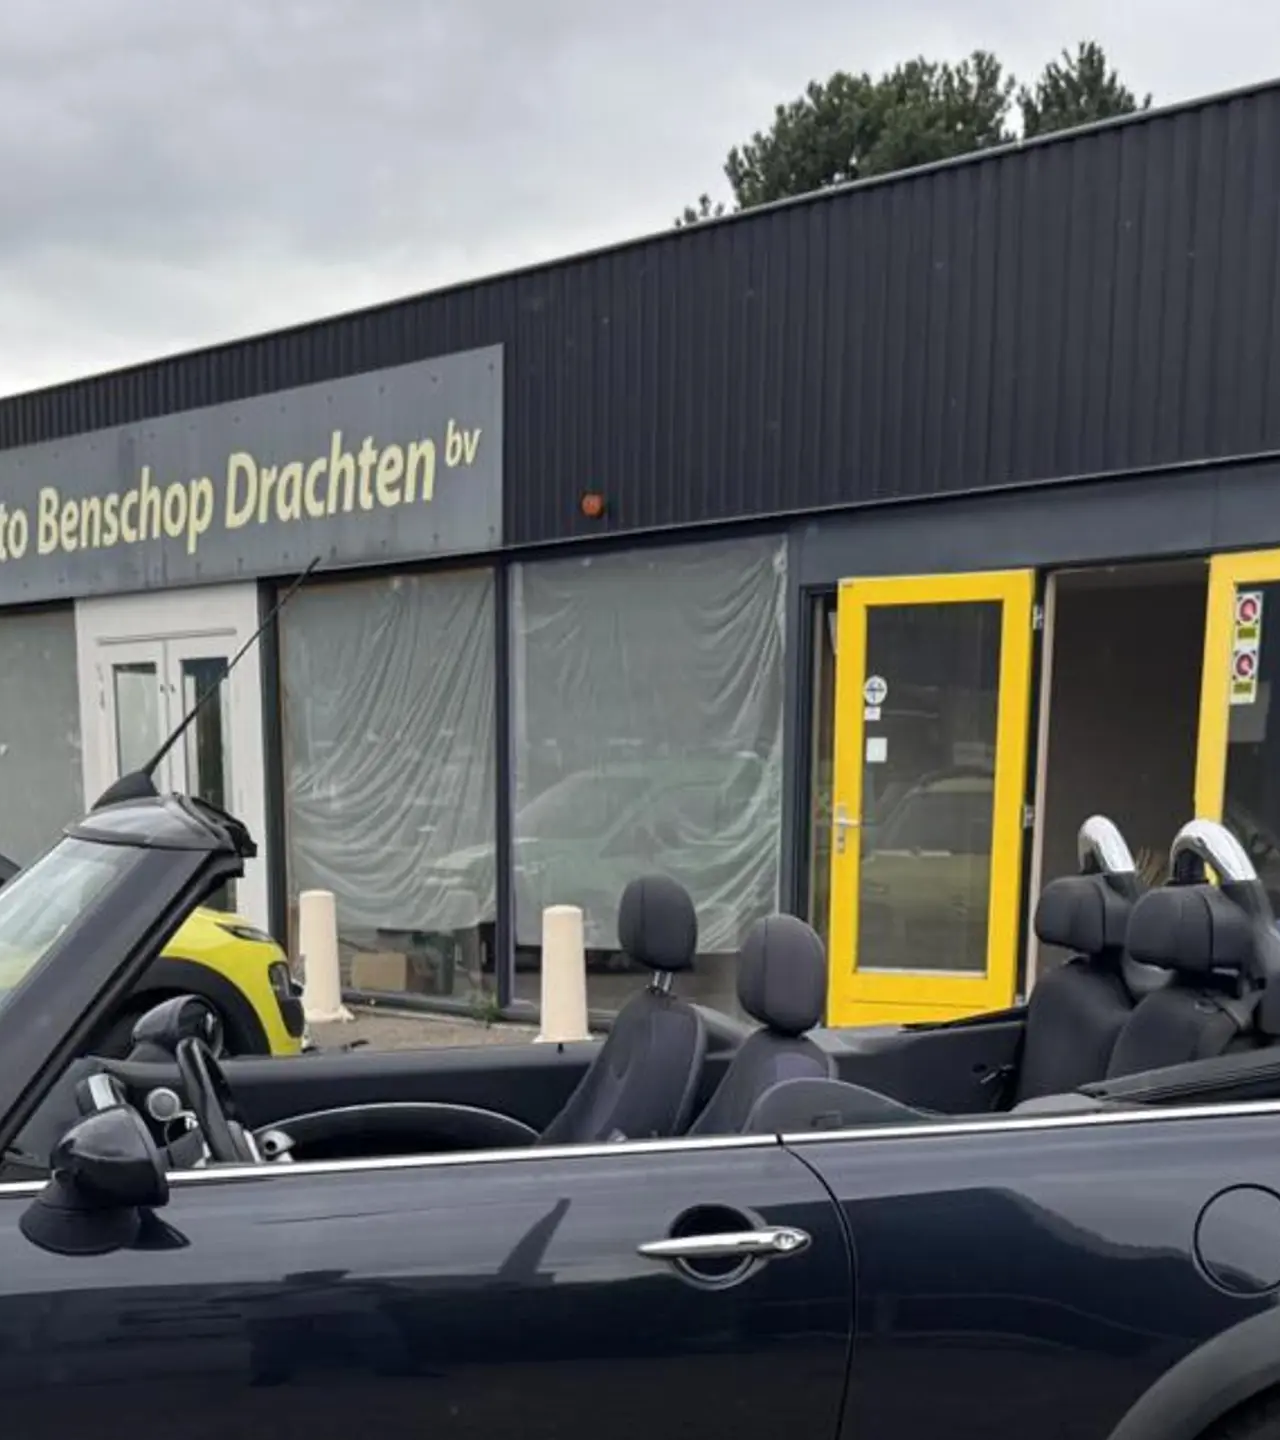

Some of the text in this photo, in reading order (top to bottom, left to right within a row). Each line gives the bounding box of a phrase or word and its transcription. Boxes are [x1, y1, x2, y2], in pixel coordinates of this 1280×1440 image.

[37, 466, 214, 553] Benschop
[225, 431, 435, 530] Drachten
[444, 418, 482, 468] bv
